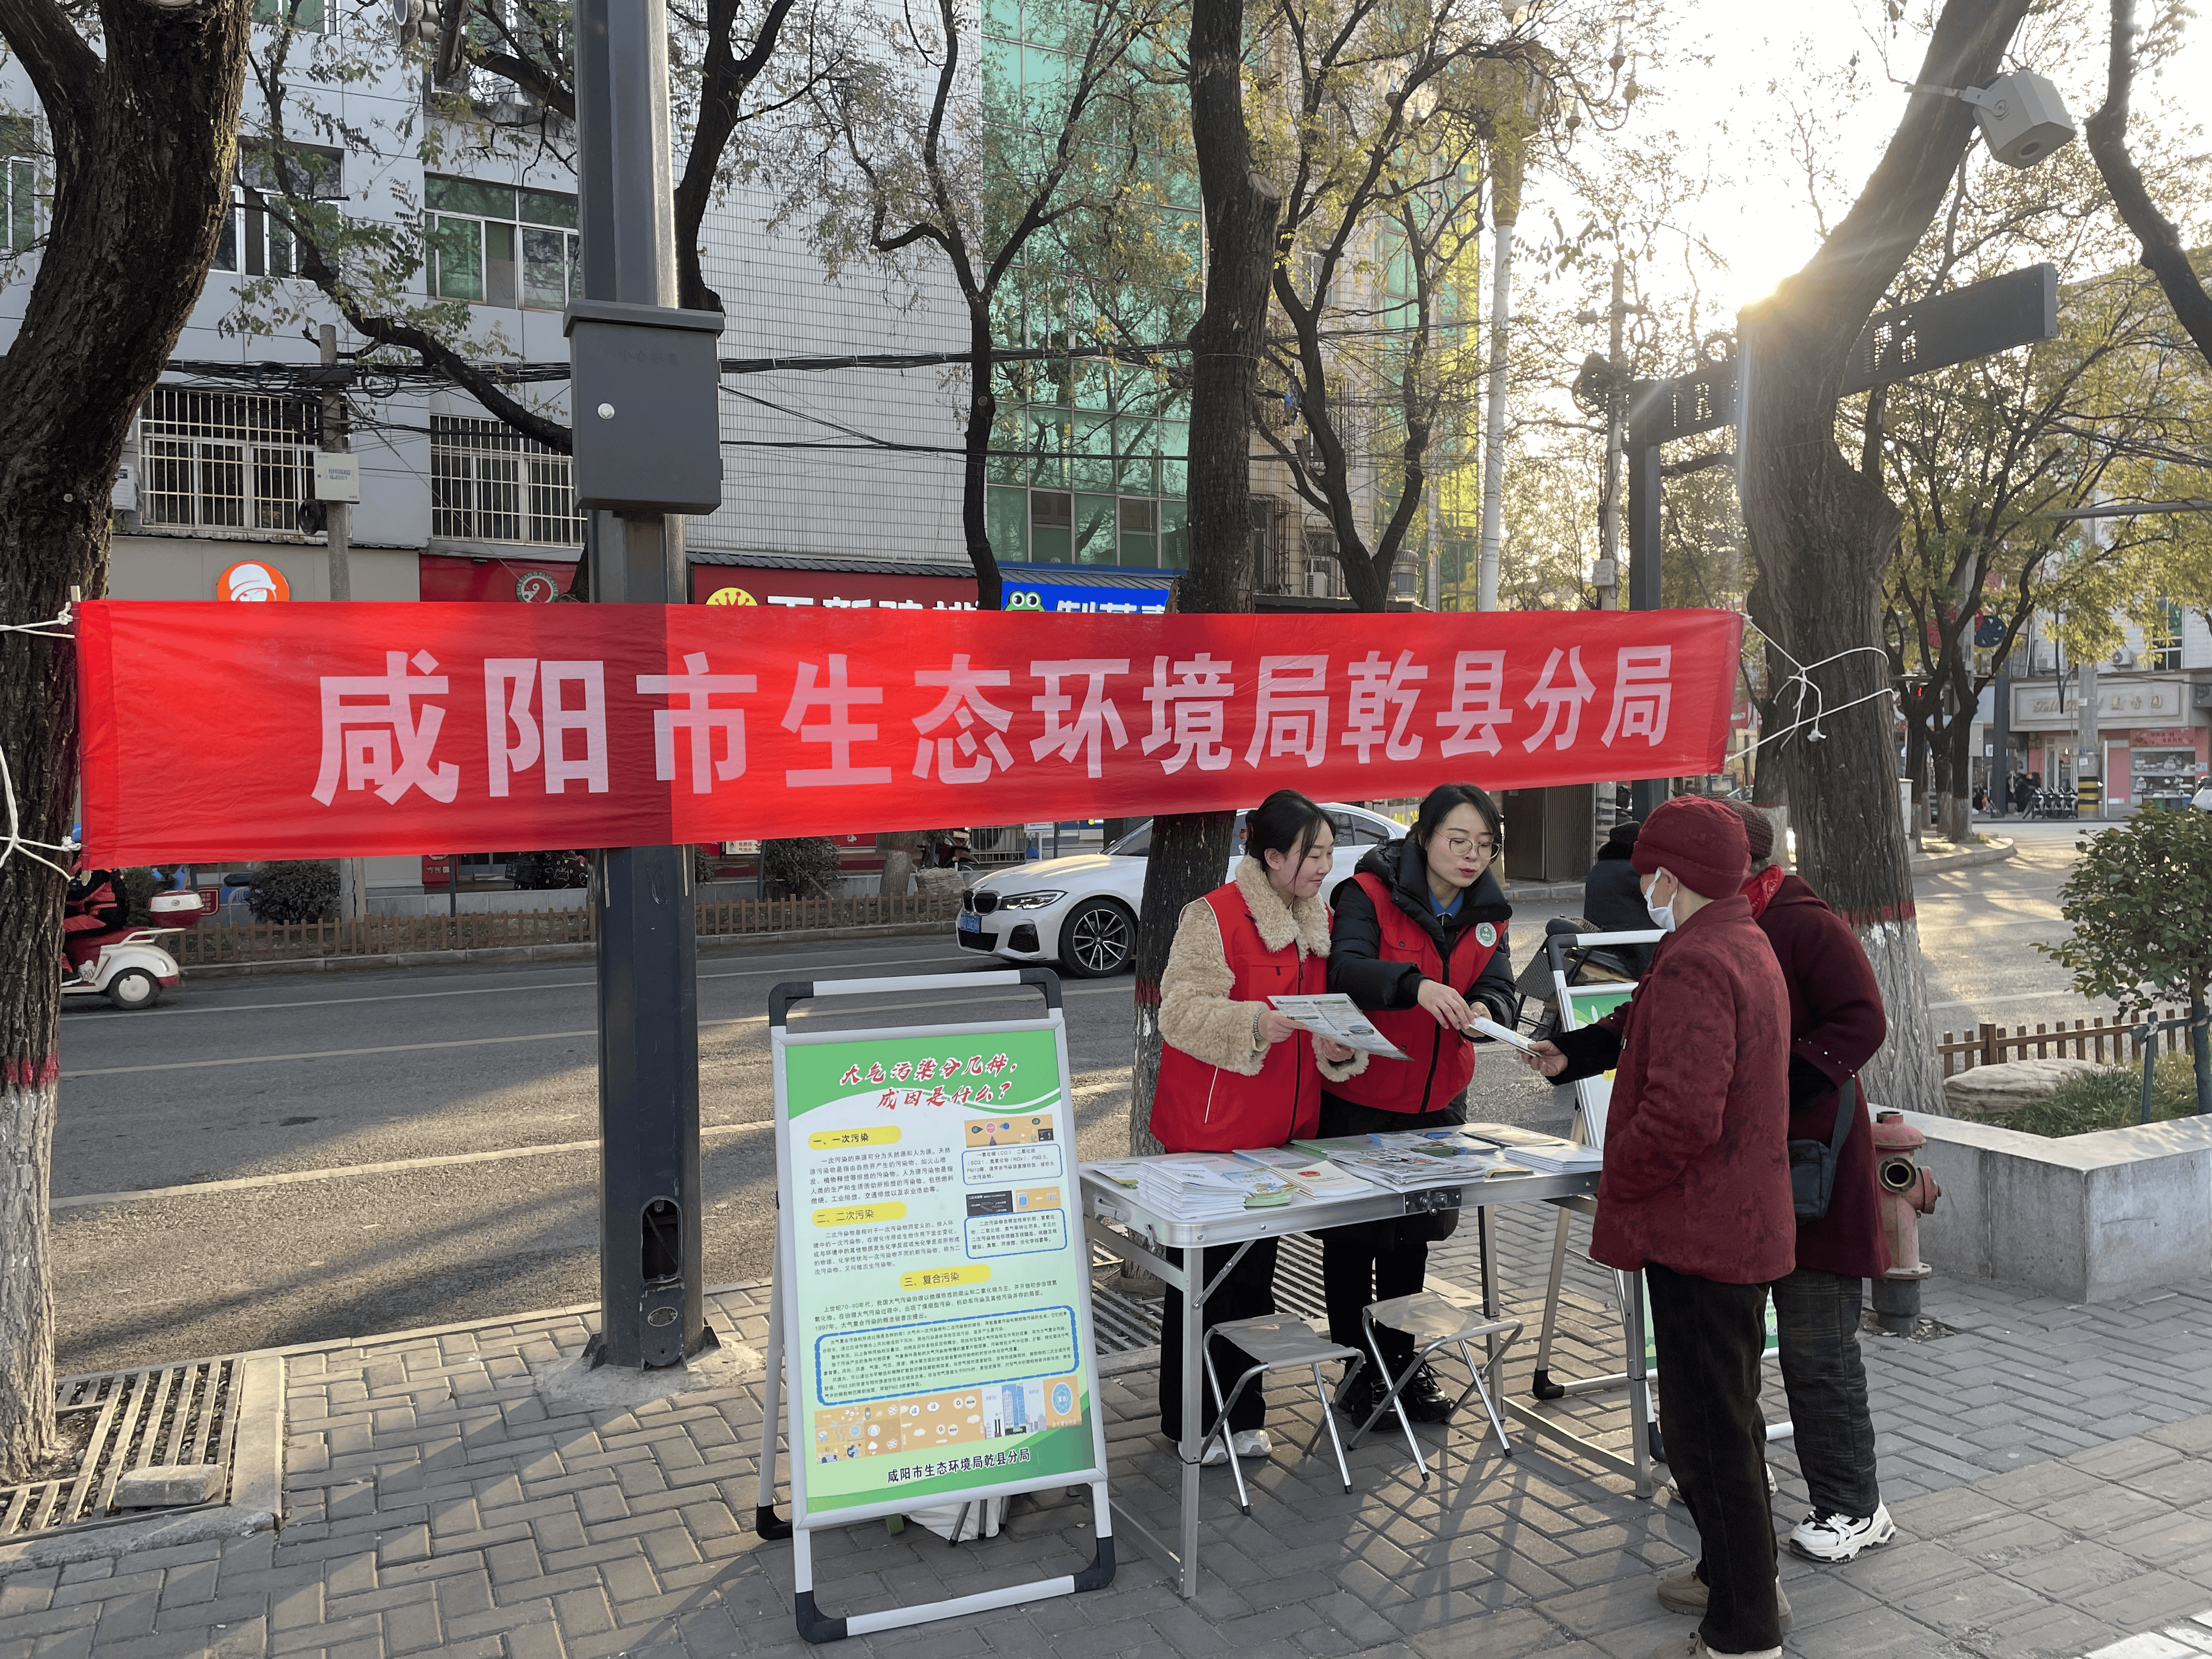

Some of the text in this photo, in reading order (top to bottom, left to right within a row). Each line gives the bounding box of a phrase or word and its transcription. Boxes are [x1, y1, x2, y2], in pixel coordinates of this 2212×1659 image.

[311, 645, 1672, 807] 咸阳市生态环境局乾县分局
[813, 1132, 869, 1145] 一、一次污染
[816, 1209, 874, 1223] 二、二次污染
[904, 1272, 960, 1286] 三、复合污染
[887, 1447, 1030, 1484] 咸阳市生态环境局乾县分局
